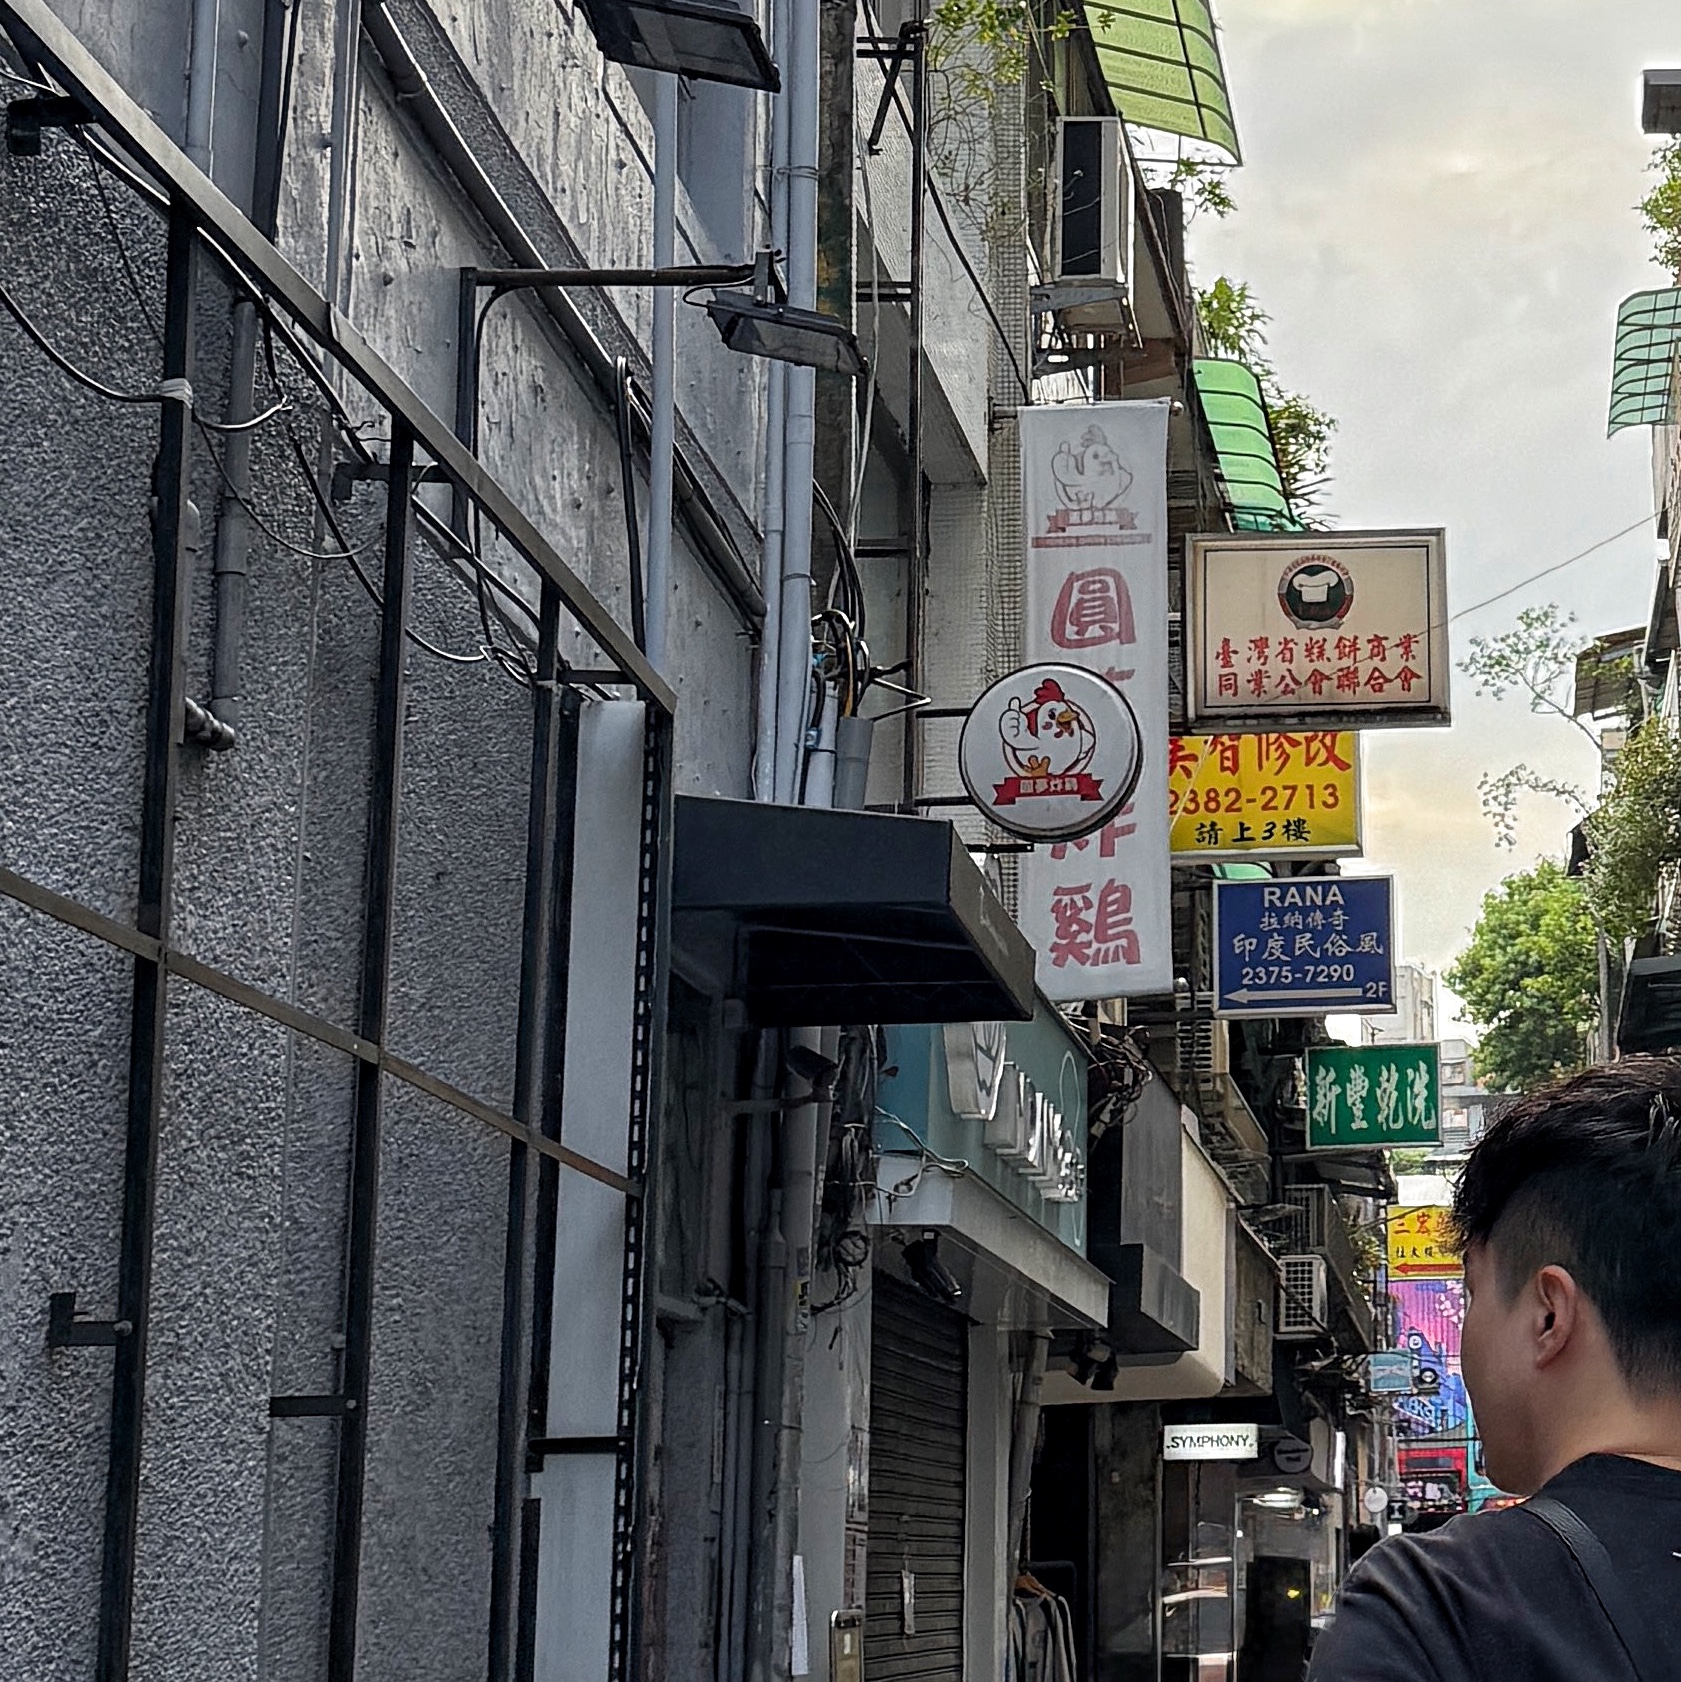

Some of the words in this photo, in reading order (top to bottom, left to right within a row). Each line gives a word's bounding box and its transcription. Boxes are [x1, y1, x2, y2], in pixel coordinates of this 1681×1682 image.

[1215, 633, 1420, 669] 臺灣省糕餅商業
[1218, 665, 1423, 697] 同業公會聯合會
[1169, 783, 1339, 815] 2382-2713
[1264, 885, 1344, 907] RANA
[1232, 932, 1383, 962] 印度民俗風
[1242, 964, 1354, 985] 2375-7290
[1365, 981, 1387, 998] 2F
